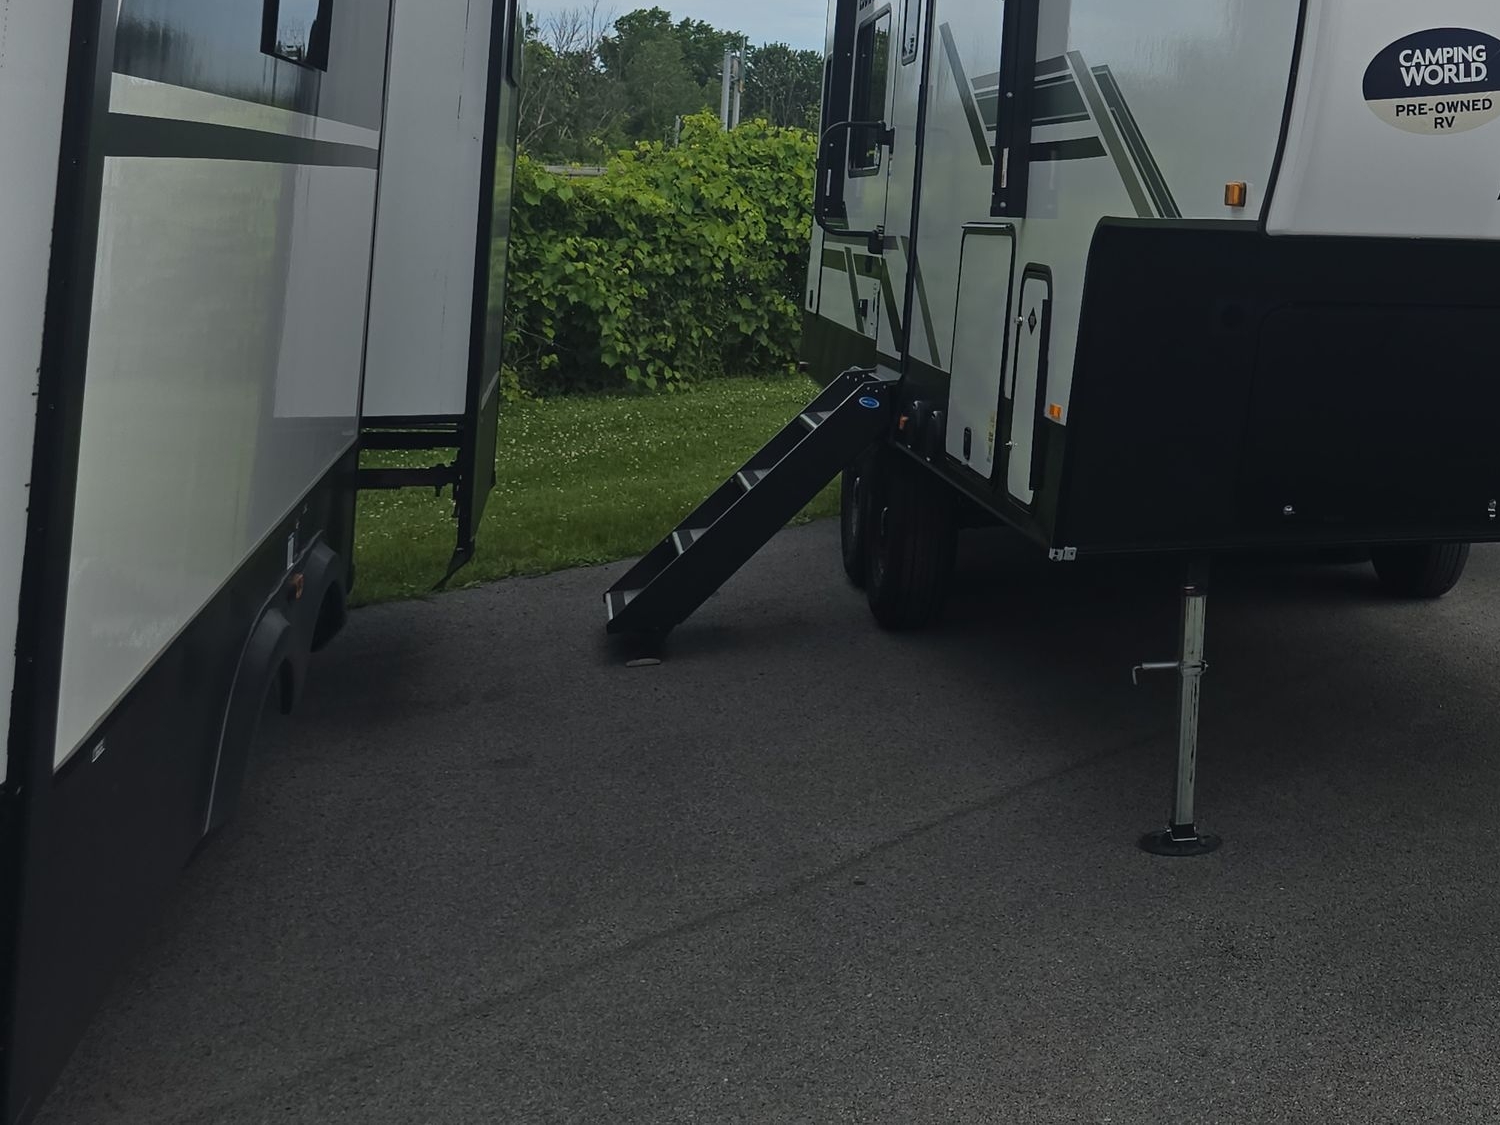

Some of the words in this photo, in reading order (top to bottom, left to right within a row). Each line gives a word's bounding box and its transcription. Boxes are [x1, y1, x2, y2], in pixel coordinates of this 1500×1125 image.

[1399, 45, 1487, 66] CAMPING
[1395, 98, 1493, 117] PRE-OWNED
[1434, 116, 1456, 129] RV
